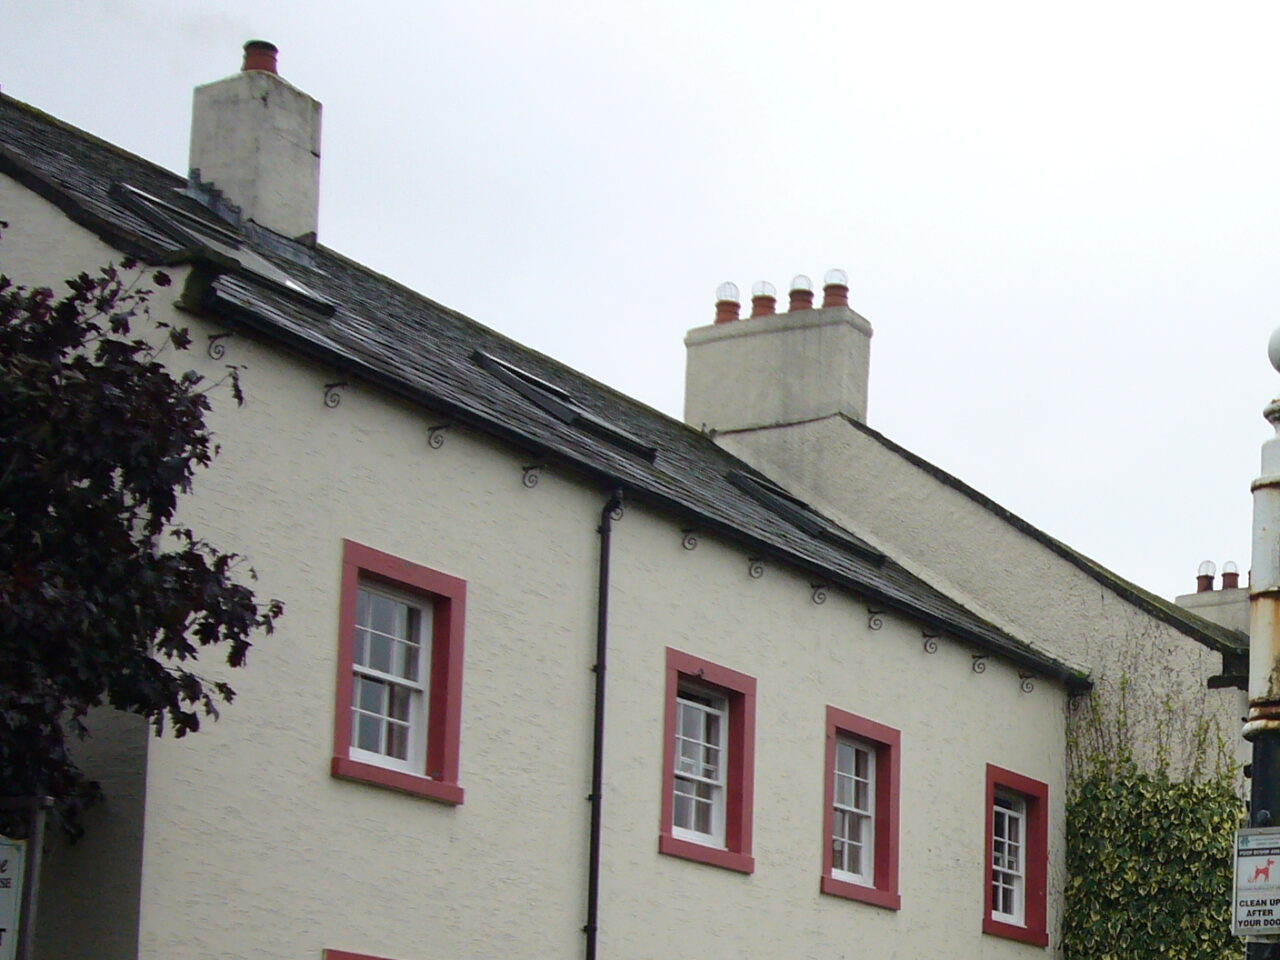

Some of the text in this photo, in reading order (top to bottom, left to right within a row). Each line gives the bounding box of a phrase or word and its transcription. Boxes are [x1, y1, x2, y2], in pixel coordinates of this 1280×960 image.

[1239, 899, 1268, 908] CLEAN
[1246, 909, 1274, 917] AFTER
[1237, 919, 1261, 928] YOUR
